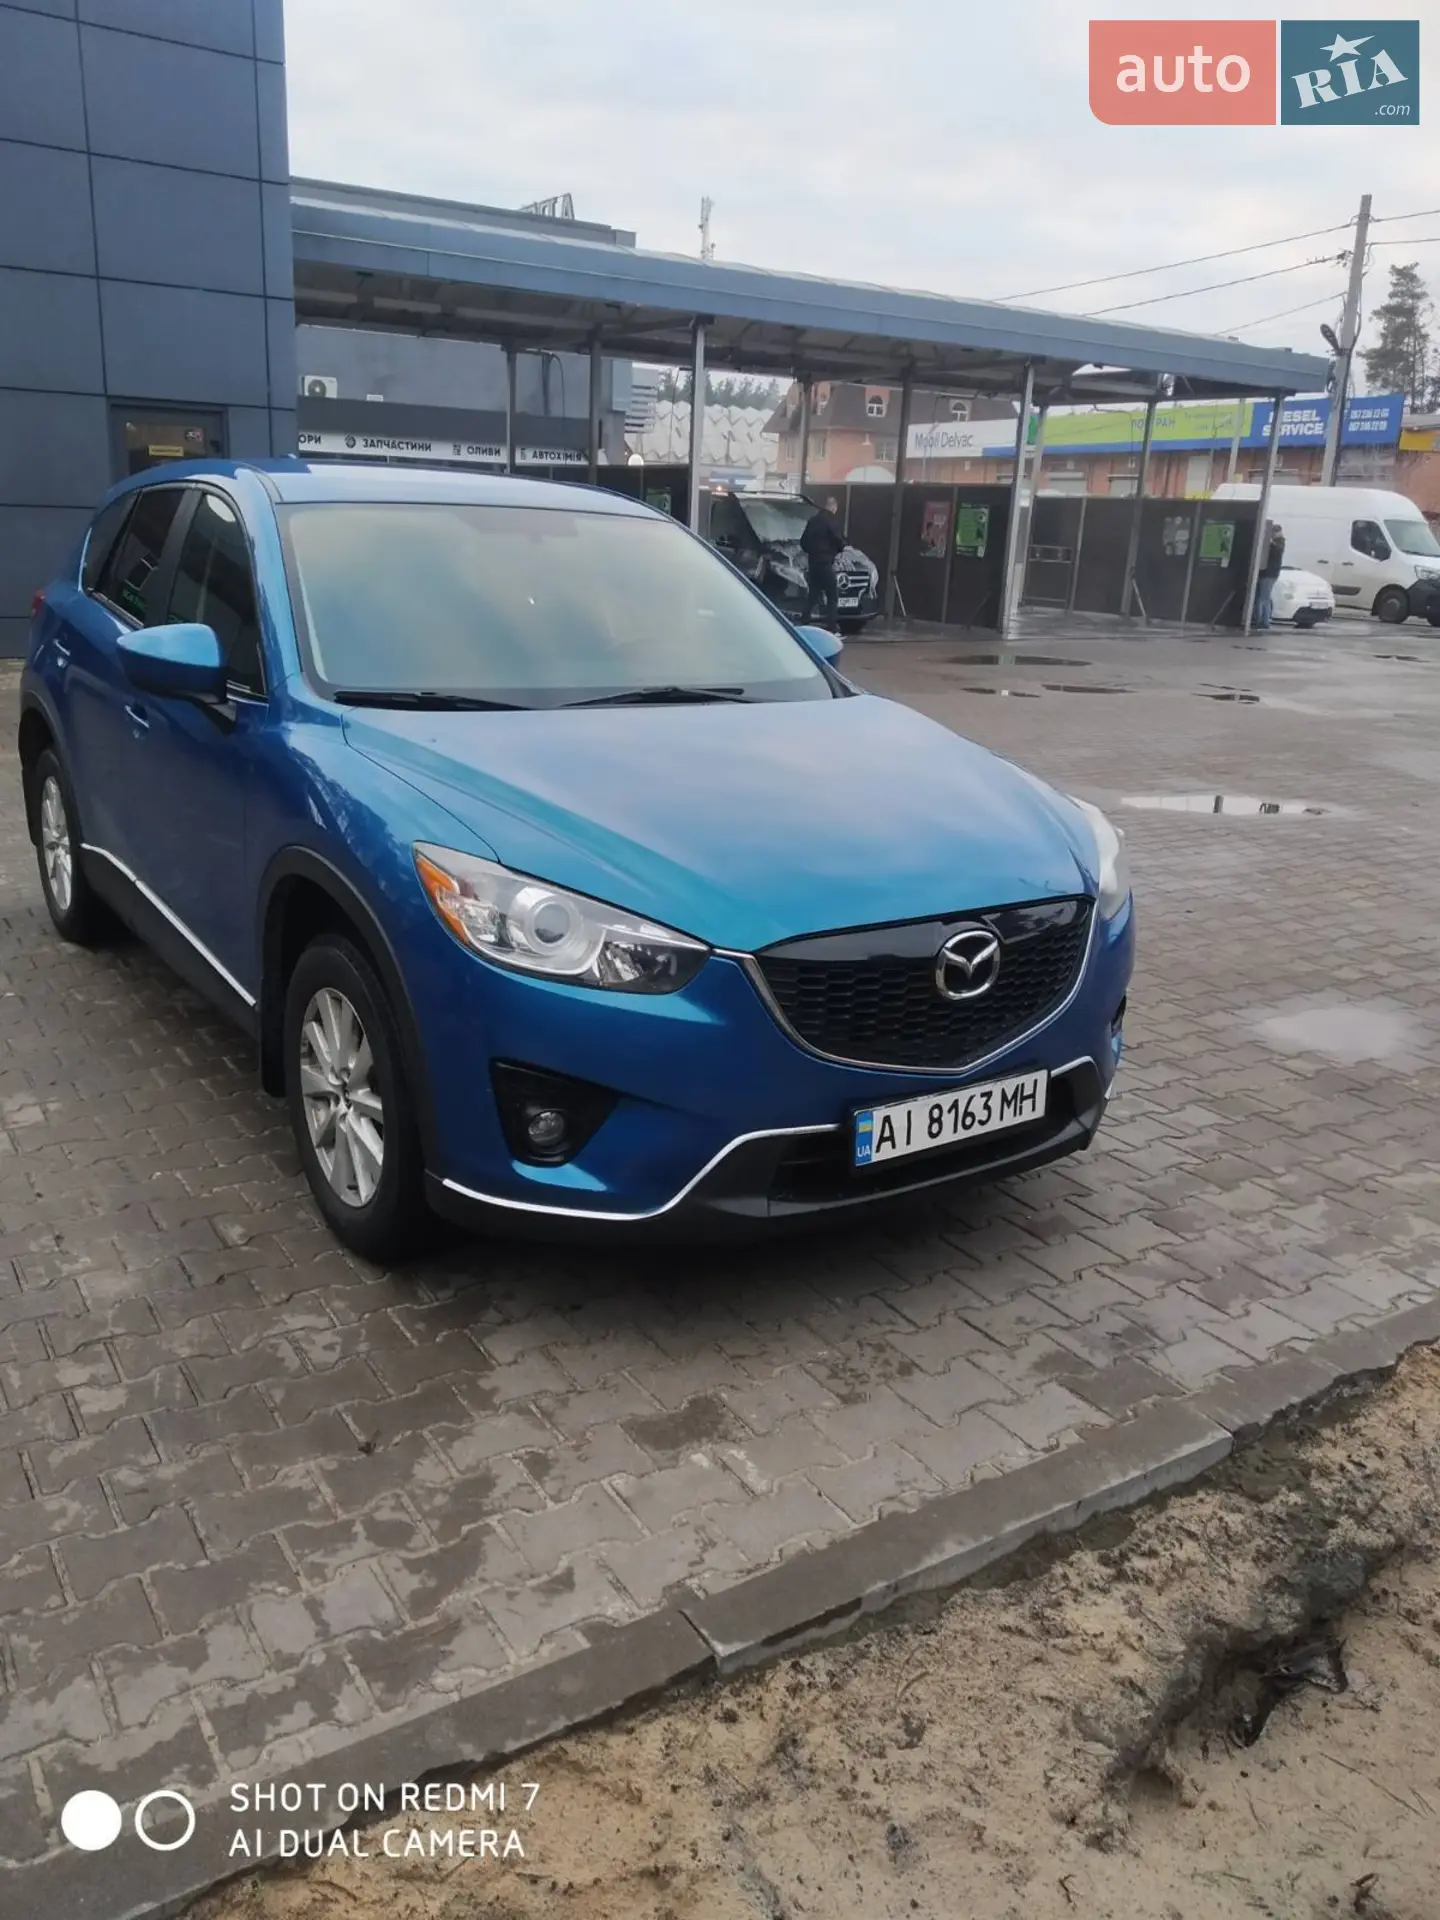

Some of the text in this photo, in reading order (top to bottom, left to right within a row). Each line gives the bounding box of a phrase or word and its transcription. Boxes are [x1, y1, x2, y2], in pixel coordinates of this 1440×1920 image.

[1261, 422, 1325, 437] SRVICE
[941, 430, 974, 448] Delvac
[362, 438, 432, 453] ЗАПЧАСТИНИ
[466, 445, 501, 457] ОЛИВИ
[531, 450, 583, 462] АВТОХІМІЯ
[875, 1078, 1038, 1153] AI 8163 MH
[857, 1145, 871, 1158] UA
